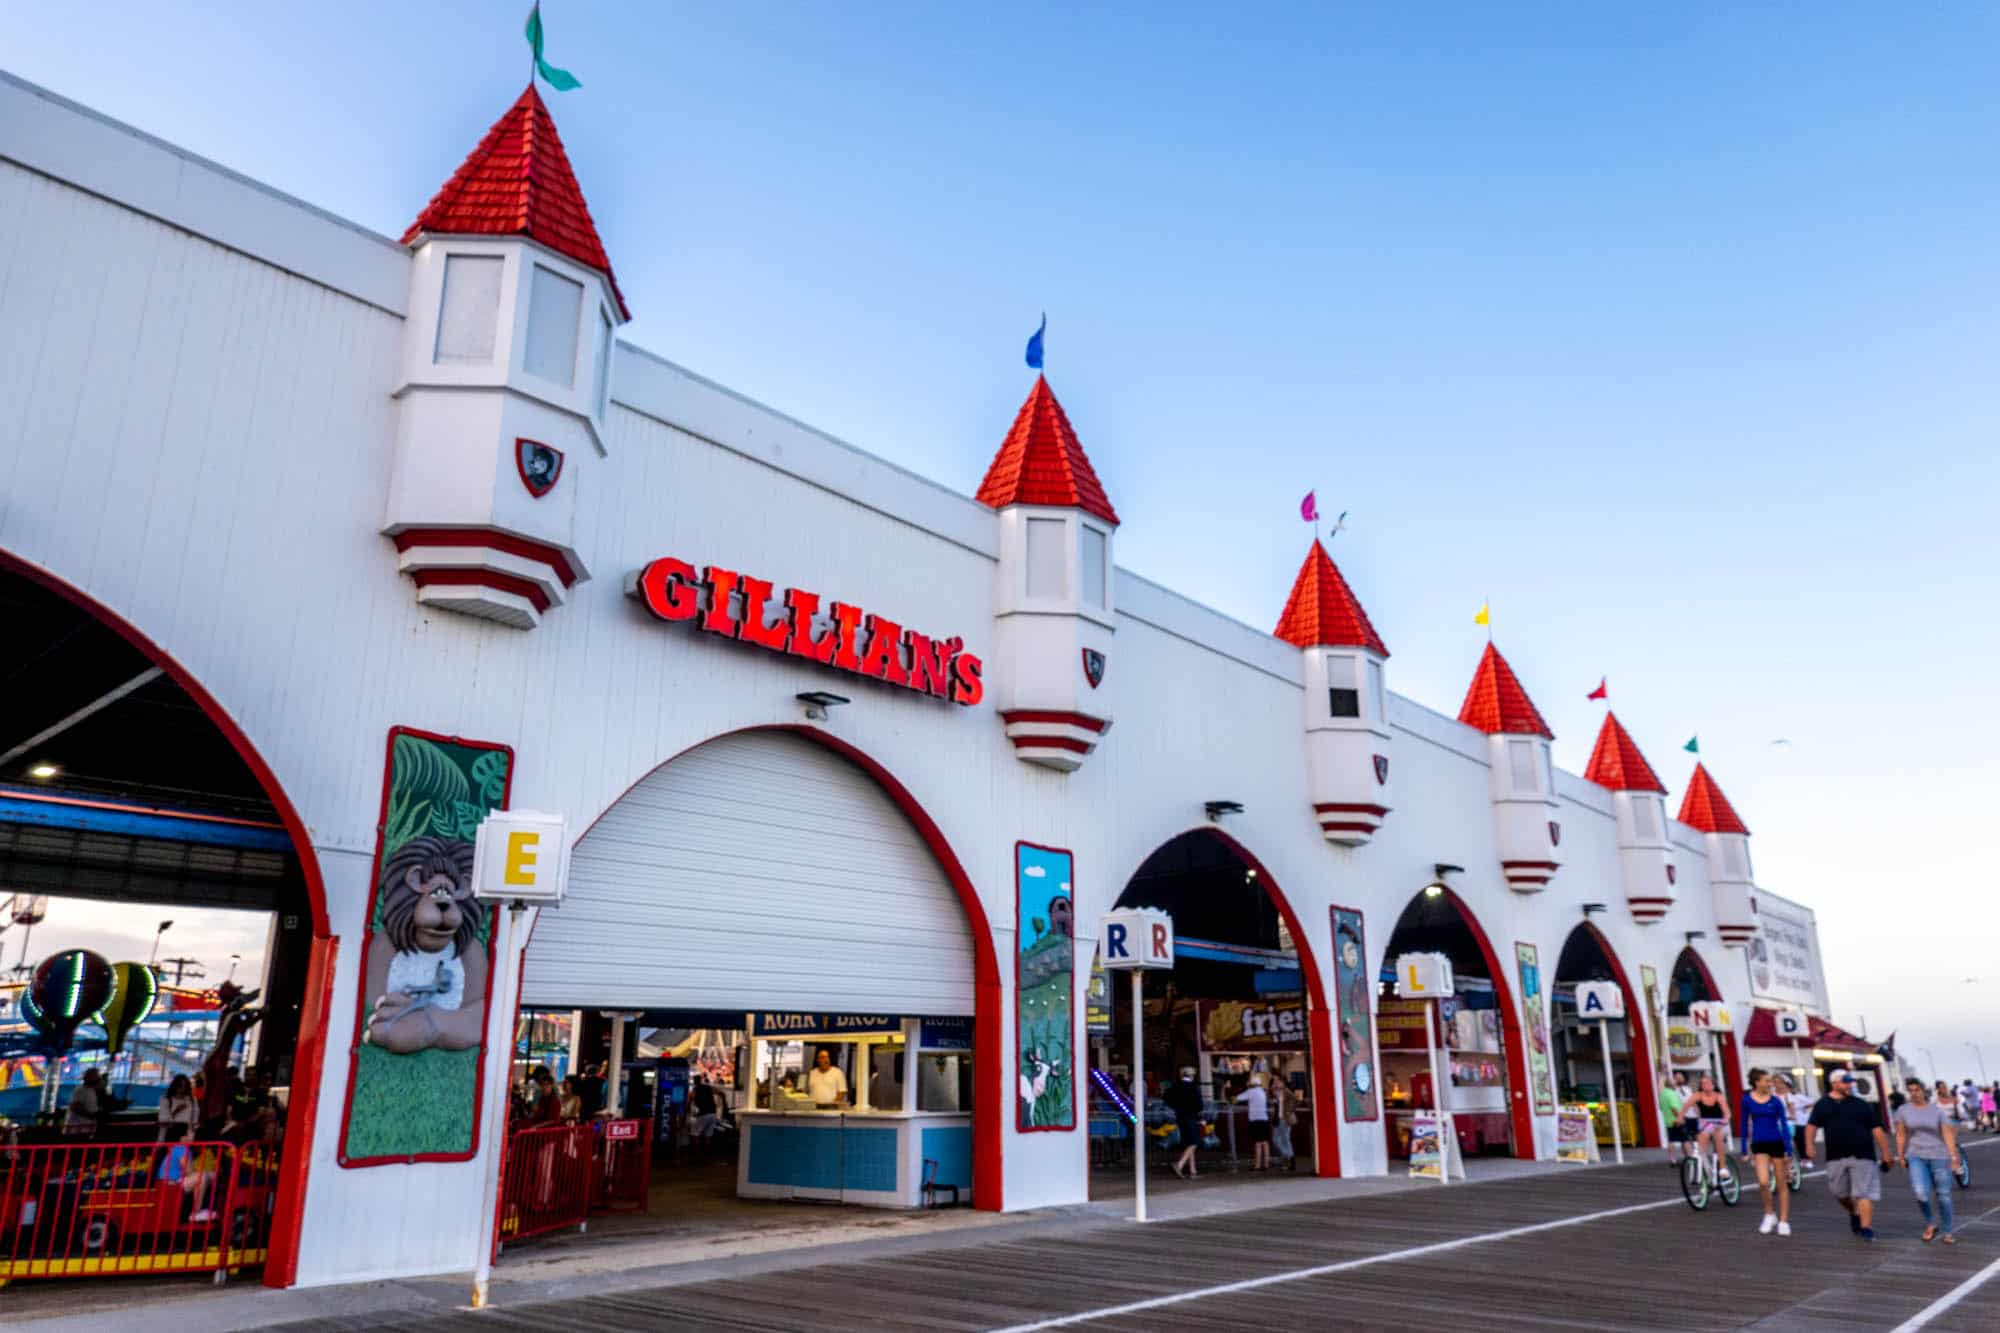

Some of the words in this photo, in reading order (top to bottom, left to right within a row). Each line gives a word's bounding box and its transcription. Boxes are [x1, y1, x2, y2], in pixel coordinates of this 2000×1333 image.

[638, 557, 983, 706] GILLIAN'S
[504, 832, 539, 885] E
[1107, 923, 1129, 958] R
[1152, 923, 1168, 959] R
[1408, 965, 1424, 991] L
[1585, 991, 1602, 1011] A
[1694, 1010, 1710, 1026] N
[1718, 1009, 1730, 1025] N
[1783, 1018, 1797, 1032] D
